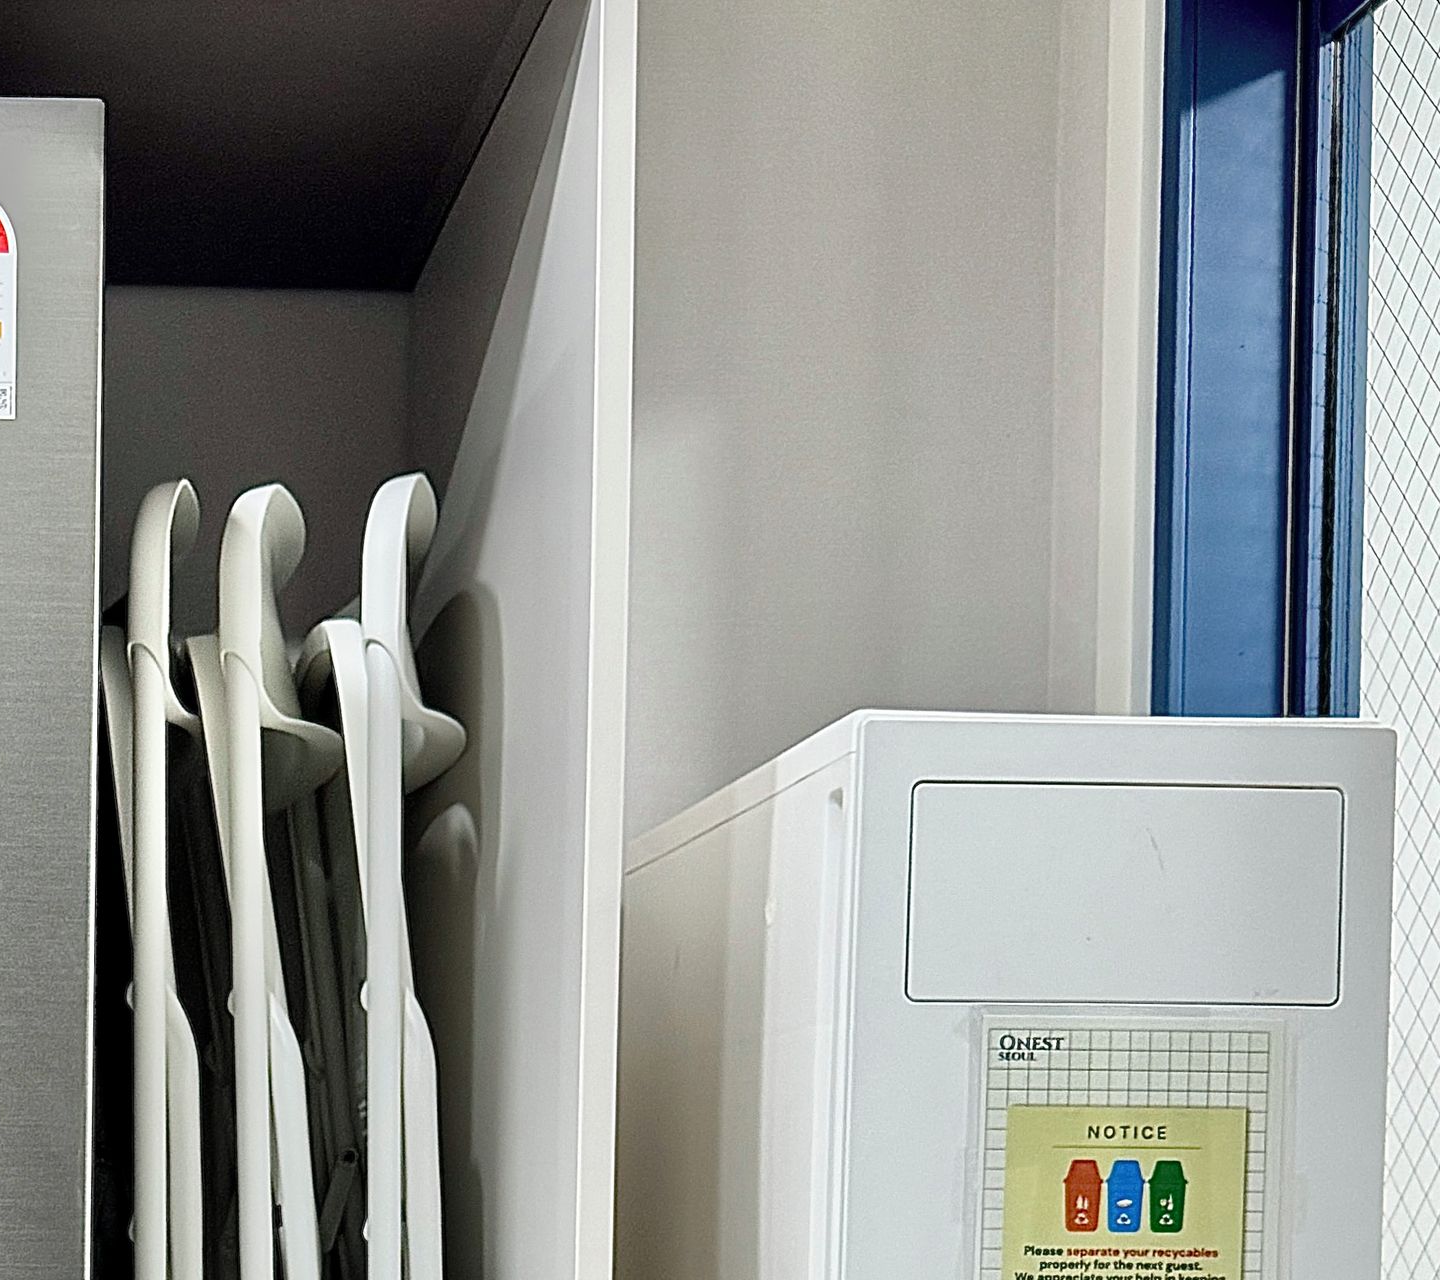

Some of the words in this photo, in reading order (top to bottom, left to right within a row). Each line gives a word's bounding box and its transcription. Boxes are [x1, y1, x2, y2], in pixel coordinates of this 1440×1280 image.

[1000, 1035, 1064, 1050] ONEST
[998, 1052, 1036, 1061] SEOUL
[1088, 1125, 1167, 1140] NOTICE
[1024, 1245, 1064, 1256] Please
[1067, 1247, 1120, 1259] separate
[1122, 1249, 1150, 1259] your
[1152, 1248, 1218, 1259] recycables
[1039, 1259, 1091, 1272] properly
[1094, 1259, 1110, 1270] for
[1114, 1260, 1134, 1270] the
[1136, 1261, 1163, 1270] next
[1166, 1261, 1202, 1273] guest.
